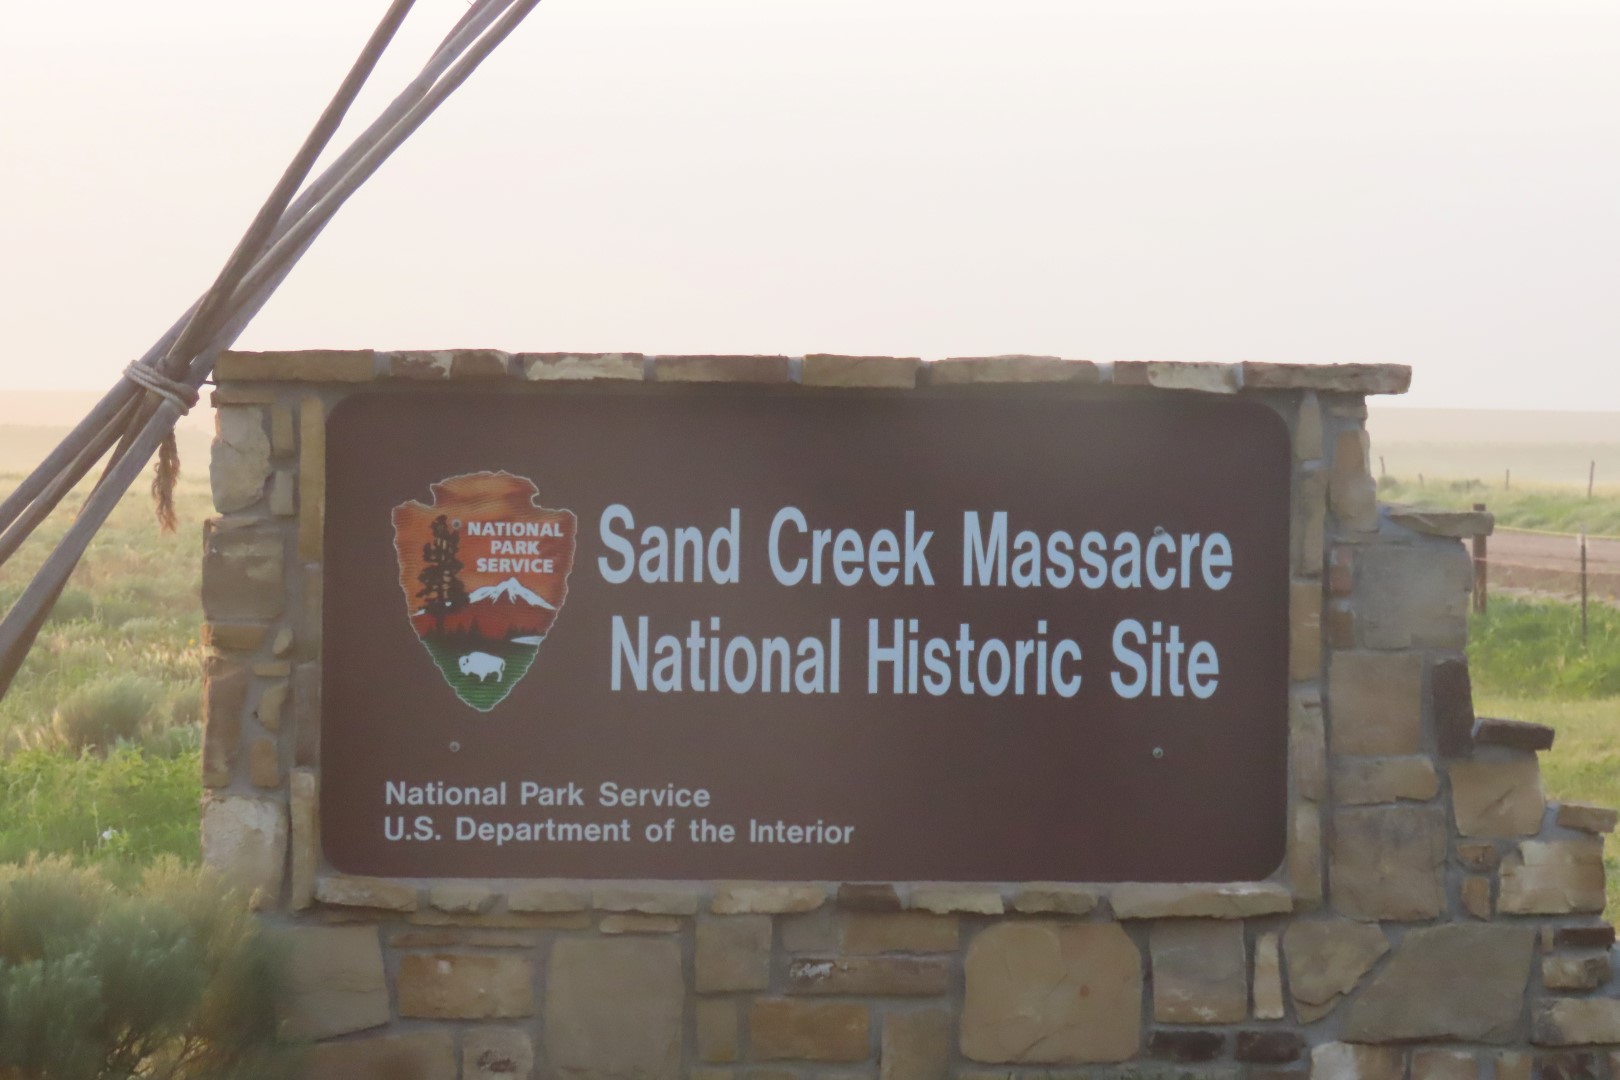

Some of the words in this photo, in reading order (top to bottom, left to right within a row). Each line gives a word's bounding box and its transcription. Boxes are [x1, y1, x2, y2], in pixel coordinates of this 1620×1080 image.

[467, 521, 564, 537] NATIONAL
[490, 540, 540, 555] PARK
[597, 503, 740, 584] Sand
[768, 506, 935, 587] Creek
[962, 510, 1233, 590] Massacre
[476, 558, 554, 573] SERVICE
[611, 615, 840, 693] National
[867, 618, 1082, 697] Historic
[1110, 618, 1220, 699] Site
[385, 781, 507, 805] National
[520, 782, 584, 806] Park
[599, 782, 711, 807] Service
[384, 817, 441, 841] U.S.
[456, 818, 631, 845] Department
[645, 819, 675, 842] of
[690, 820, 736, 843] the
[750, 819, 855, 844] Interior
